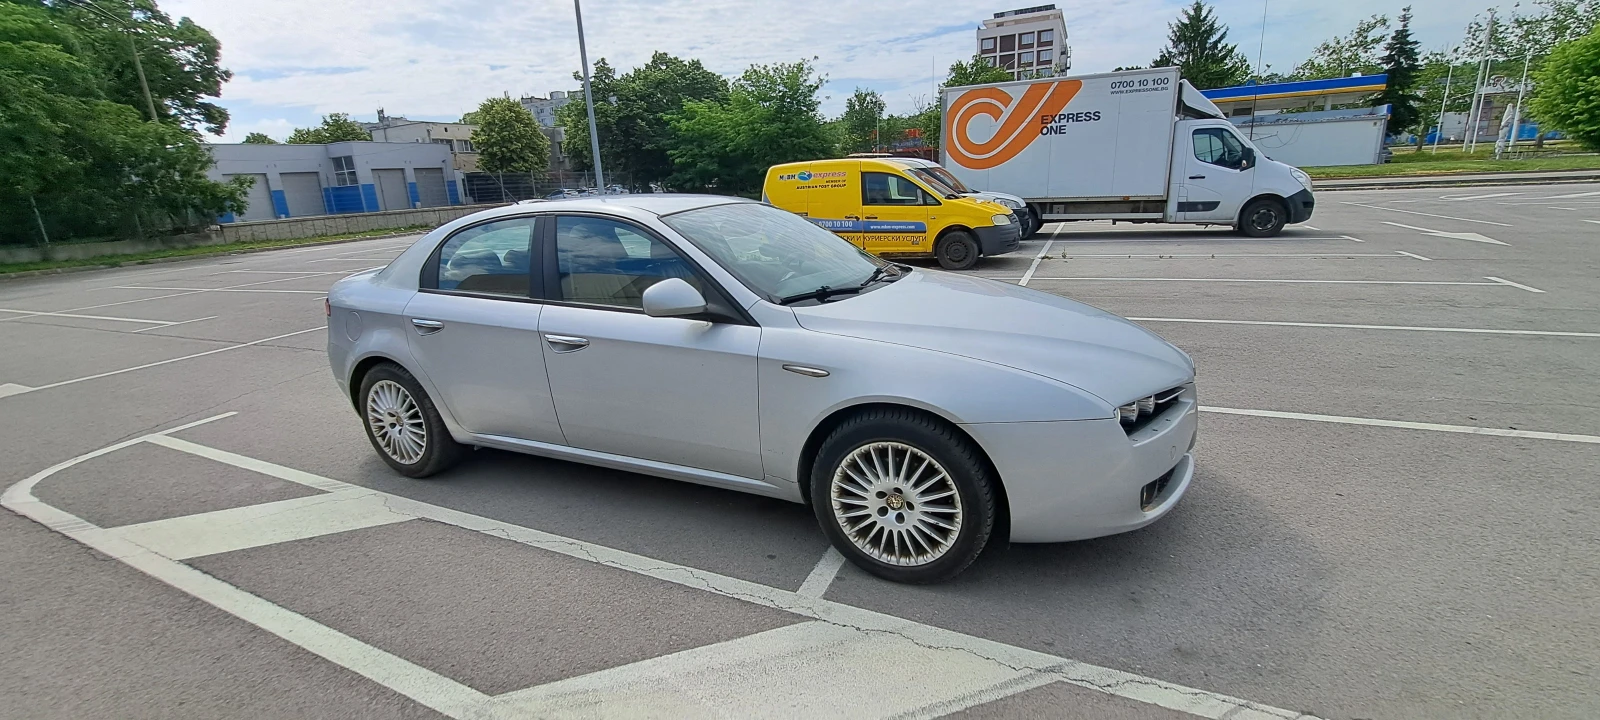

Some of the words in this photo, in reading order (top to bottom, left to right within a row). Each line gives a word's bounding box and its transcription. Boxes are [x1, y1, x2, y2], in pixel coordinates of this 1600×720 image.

[1111, 80, 1135, 89] 0700
[1137, 79, 1149, 87] 10
[1152, 77, 1169, 86] 100
[1110, 87, 1169, 95] WWW.EXPRESSONE.BG
[1041, 111, 1101, 124] EXPRESS
[1040, 125, 1067, 136] ONE
[813, 171, 847, 179] express
[833, 220, 841, 228] 10
[842, 220, 853, 228] 100
